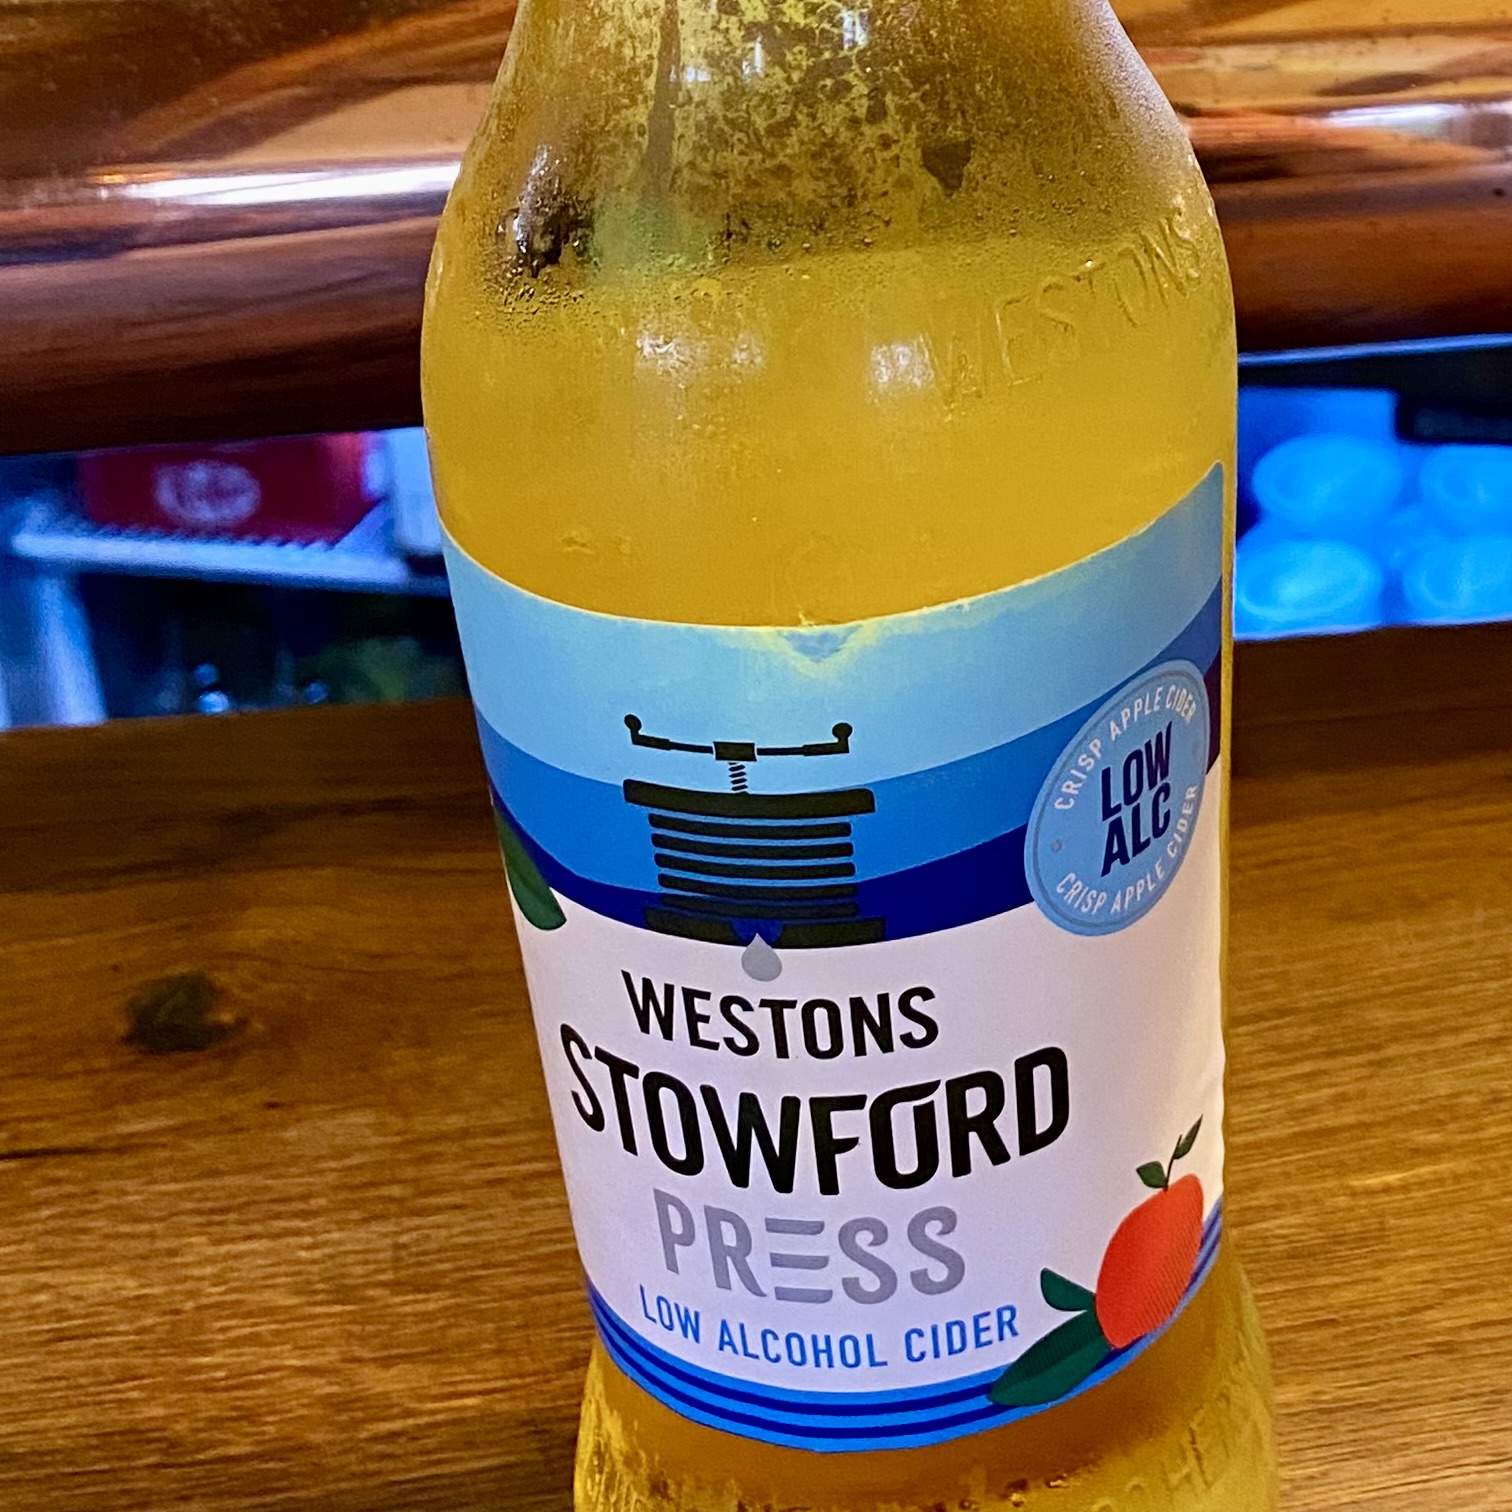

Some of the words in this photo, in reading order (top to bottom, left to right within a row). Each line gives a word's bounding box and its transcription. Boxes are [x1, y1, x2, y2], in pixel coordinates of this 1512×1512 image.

[1054, 738, 1102, 810] CRISP
[1108, 686, 1165, 742] APPLE
[1164, 684, 1198, 724] CIDER
[1101, 720, 1173, 822] LOW
[1055, 872, 1107, 915] CRISP
[1109, 859, 1165, 914] APPLE
[1166, 784, 1199, 859] CIDER
[1100, 782, 1171, 877] ALC
[621, 969, 940, 1060] WESTONS
[559, 1022, 1070, 1195] STOWFORD
[653, 1188, 966, 1305] PRESS
[639, 1284, 700, 1344] LOW
[718, 1318, 888, 1368] ALCOHOL
[905, 1303, 1020, 1363] CIDER
